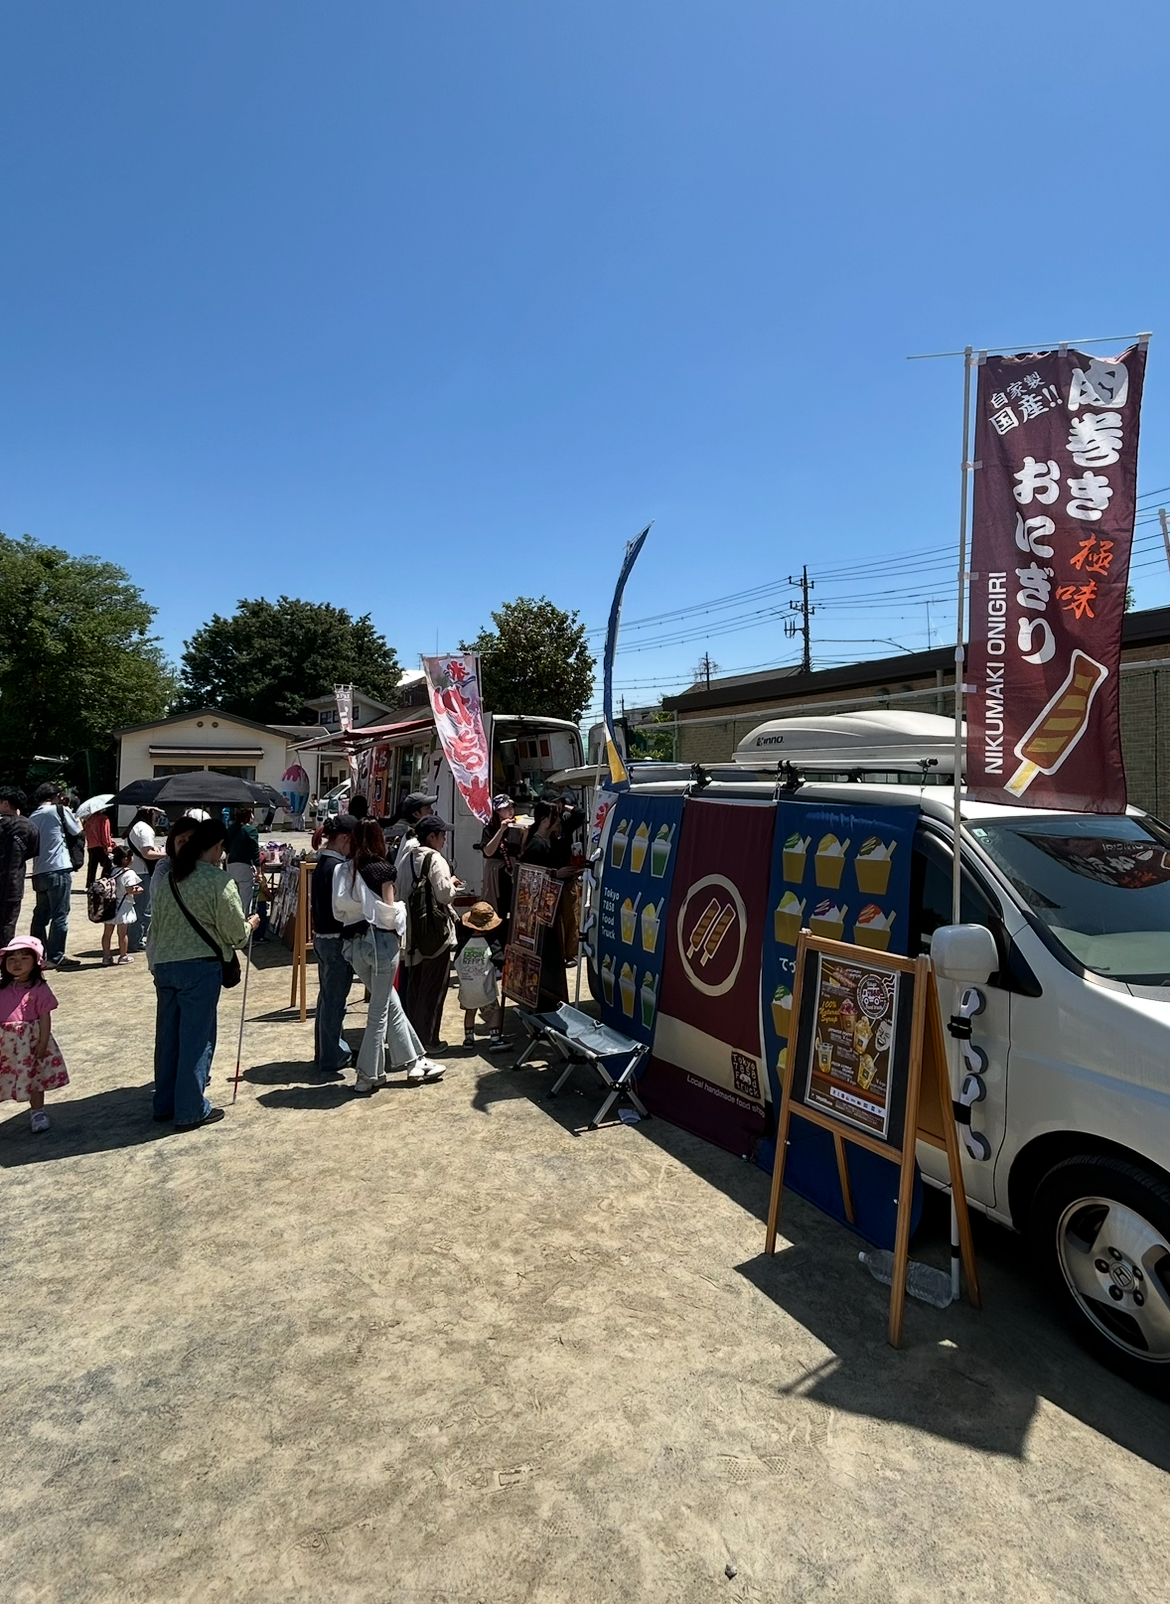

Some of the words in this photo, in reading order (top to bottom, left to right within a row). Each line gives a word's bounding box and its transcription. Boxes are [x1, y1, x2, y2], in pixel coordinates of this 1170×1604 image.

[990, 371, 1046, 408] 自家製
[1012, 456, 1061, 665] おにぎり
[986, 571, 1007, 656] ONIGIRI
[984, 660, 1005, 775] NIKUMAKI
[604, 886, 620, 901] Tokyo
[733, 1053, 756, 1070] Tokyo
[686, 1074, 704, 1089] Local
[704, 1082, 736, 1104] handmade
[736, 1098, 751, 1110] food
[751, 1105, 766, 1118] shop
